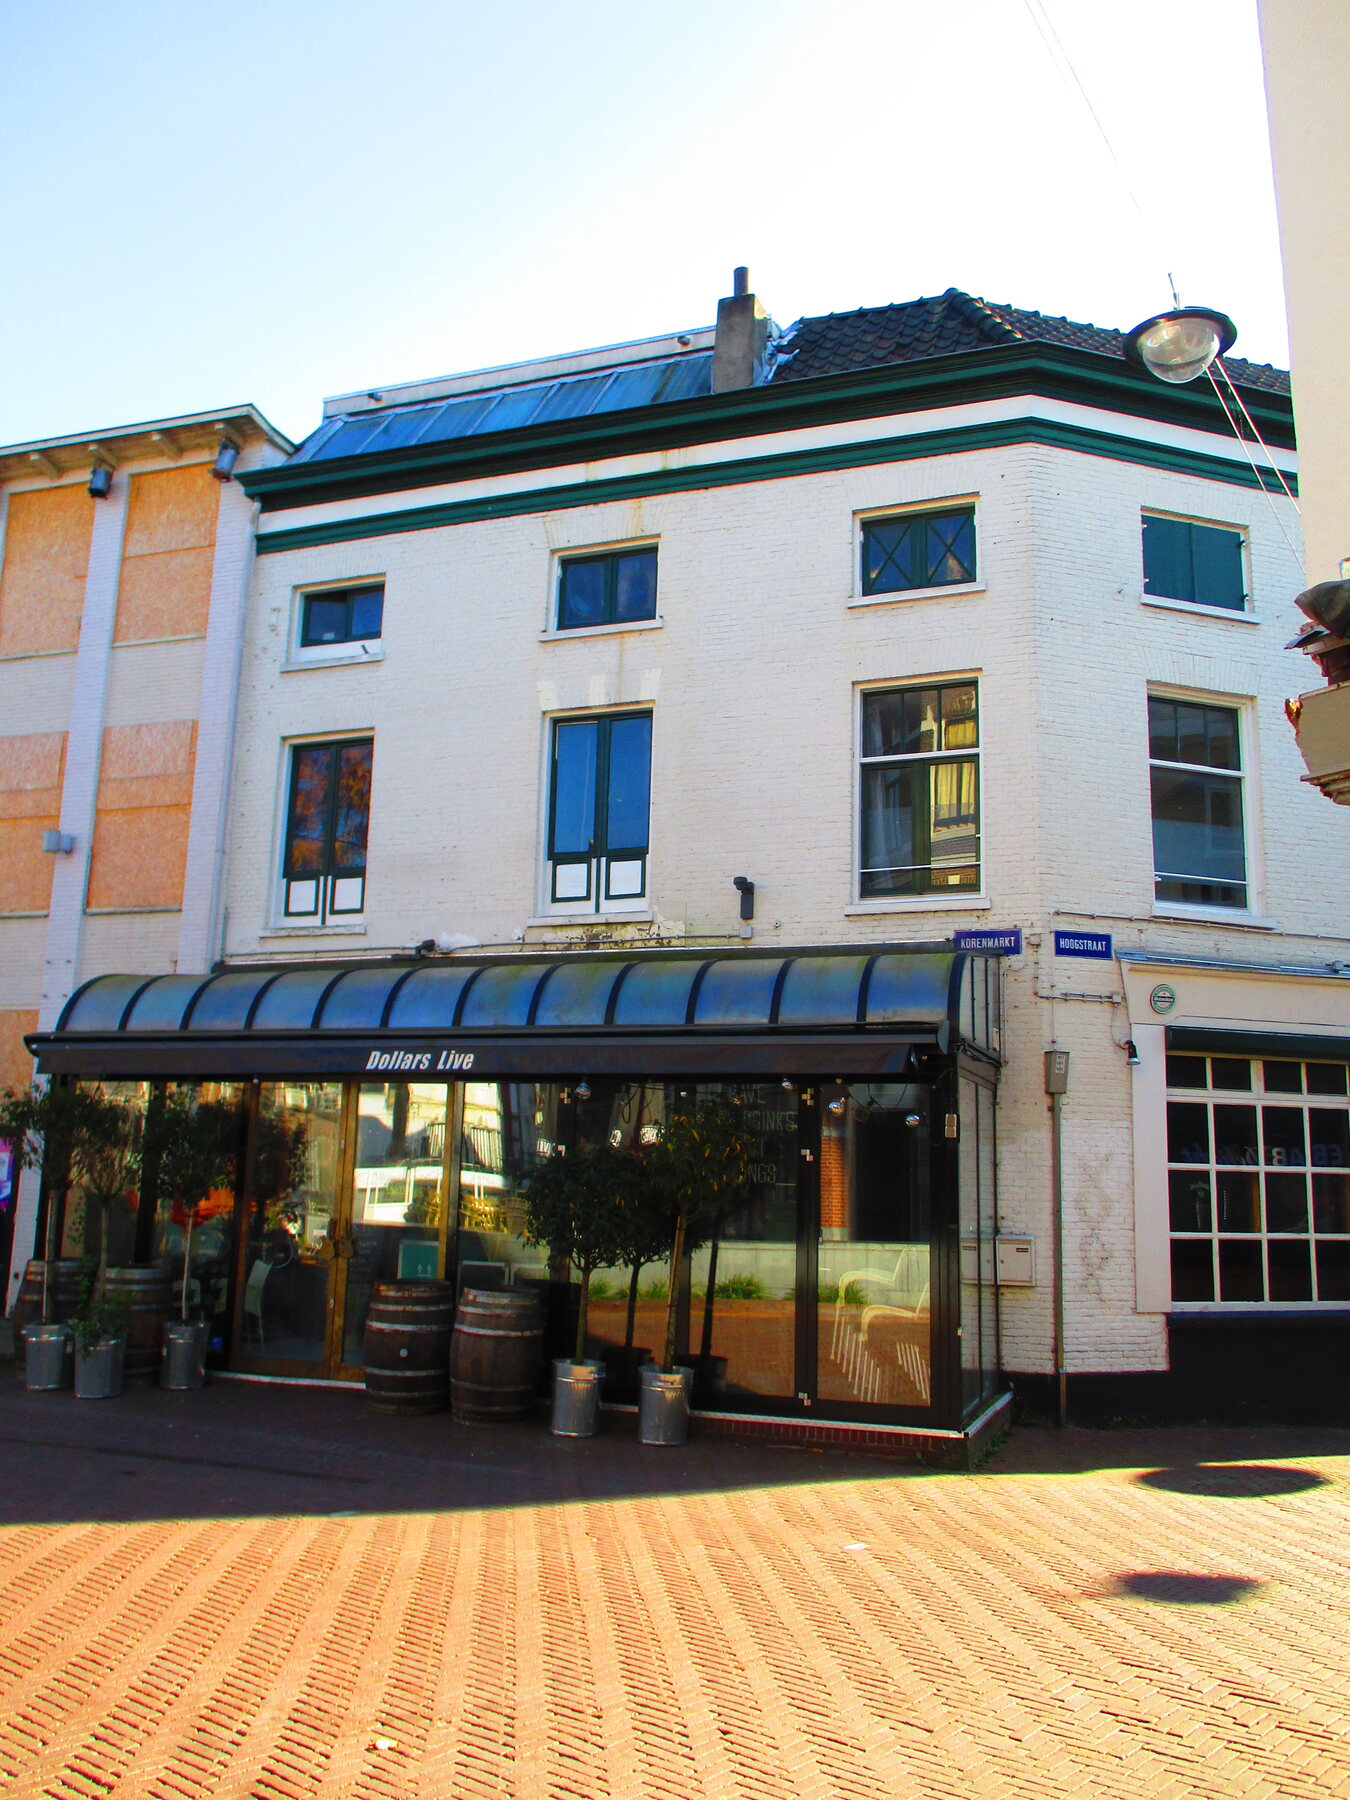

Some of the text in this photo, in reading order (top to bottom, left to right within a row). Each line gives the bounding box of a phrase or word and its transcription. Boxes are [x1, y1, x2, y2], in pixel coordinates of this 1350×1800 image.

[960, 936, 1016, 950] KORENMARKT
[1060, 938, 1107, 952] HOOGSTRAAT
[365, 1050, 474, 1070] Dollars Live
